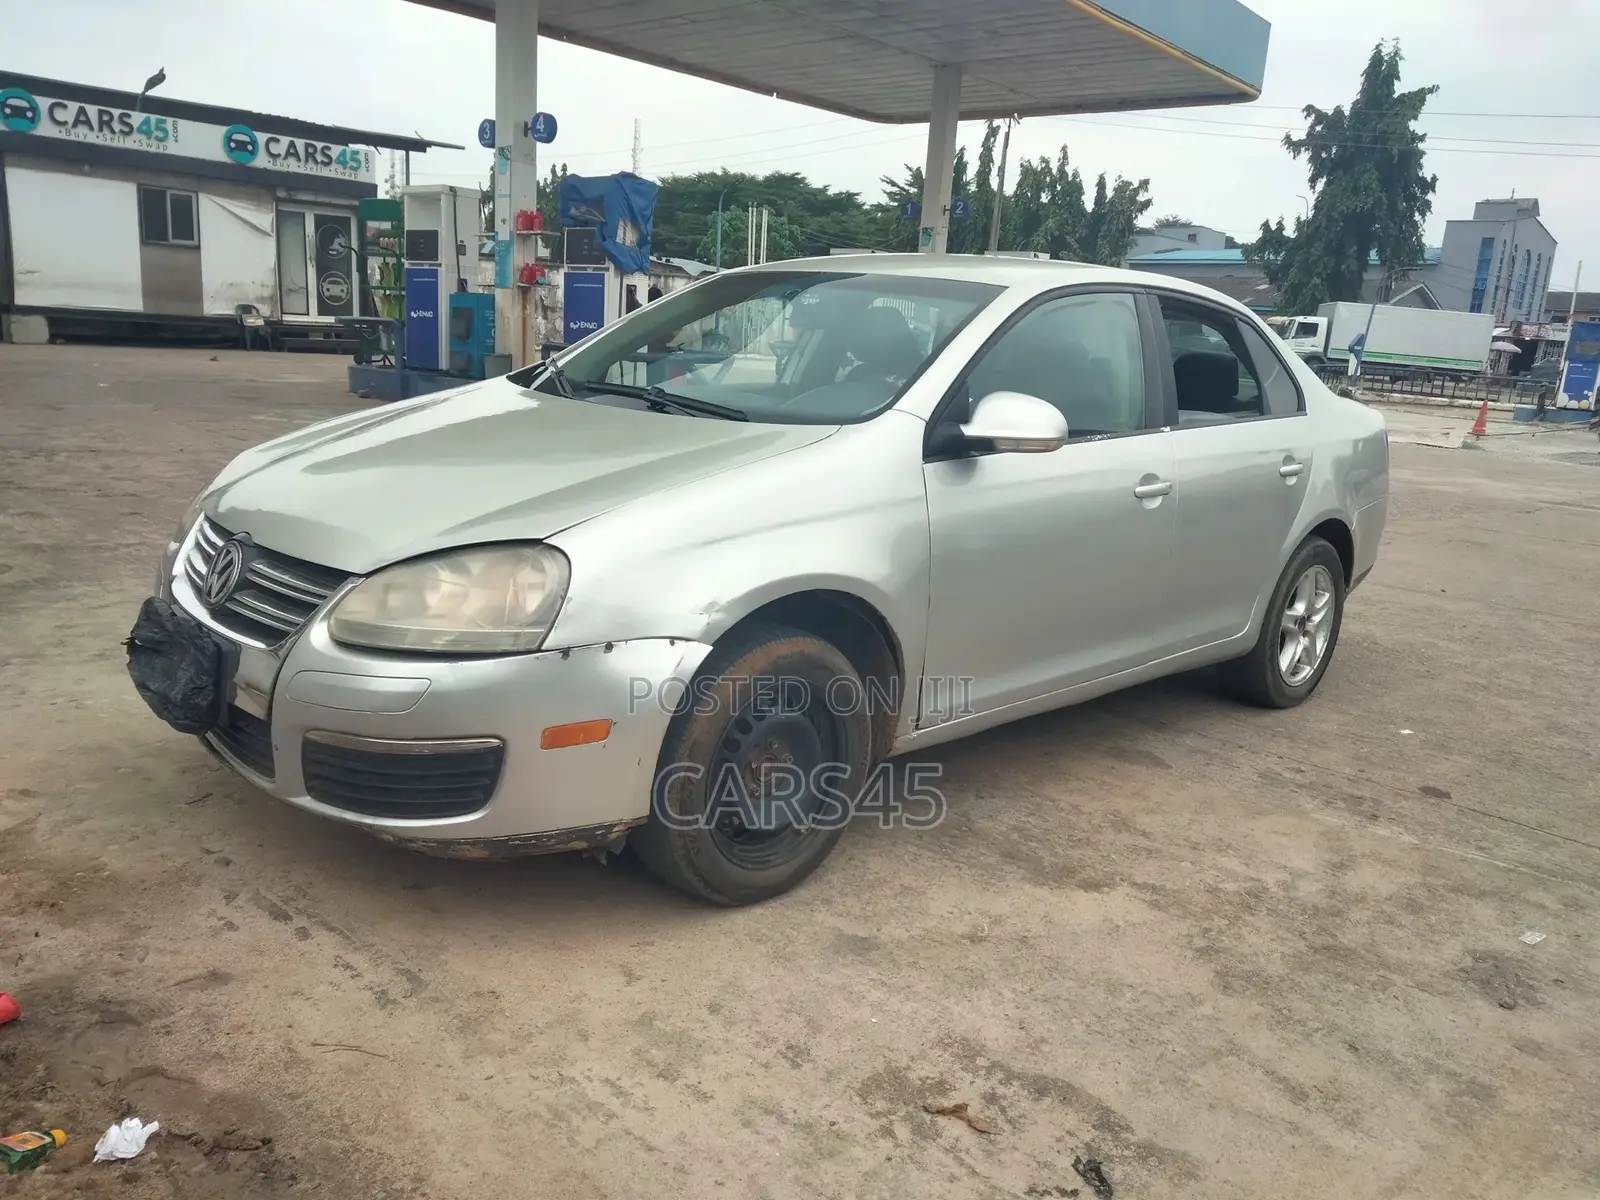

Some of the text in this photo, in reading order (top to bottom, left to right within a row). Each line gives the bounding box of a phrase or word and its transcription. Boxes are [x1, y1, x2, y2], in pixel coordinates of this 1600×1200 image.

[47, 100, 170, 142] CARS45
[535, 114, 545, 132] 4
[483, 122, 491, 139] 3
[264, 136, 362, 172] CARS45
[906, 202, 912, 215] 1
[955, 201, 964, 214] 2
